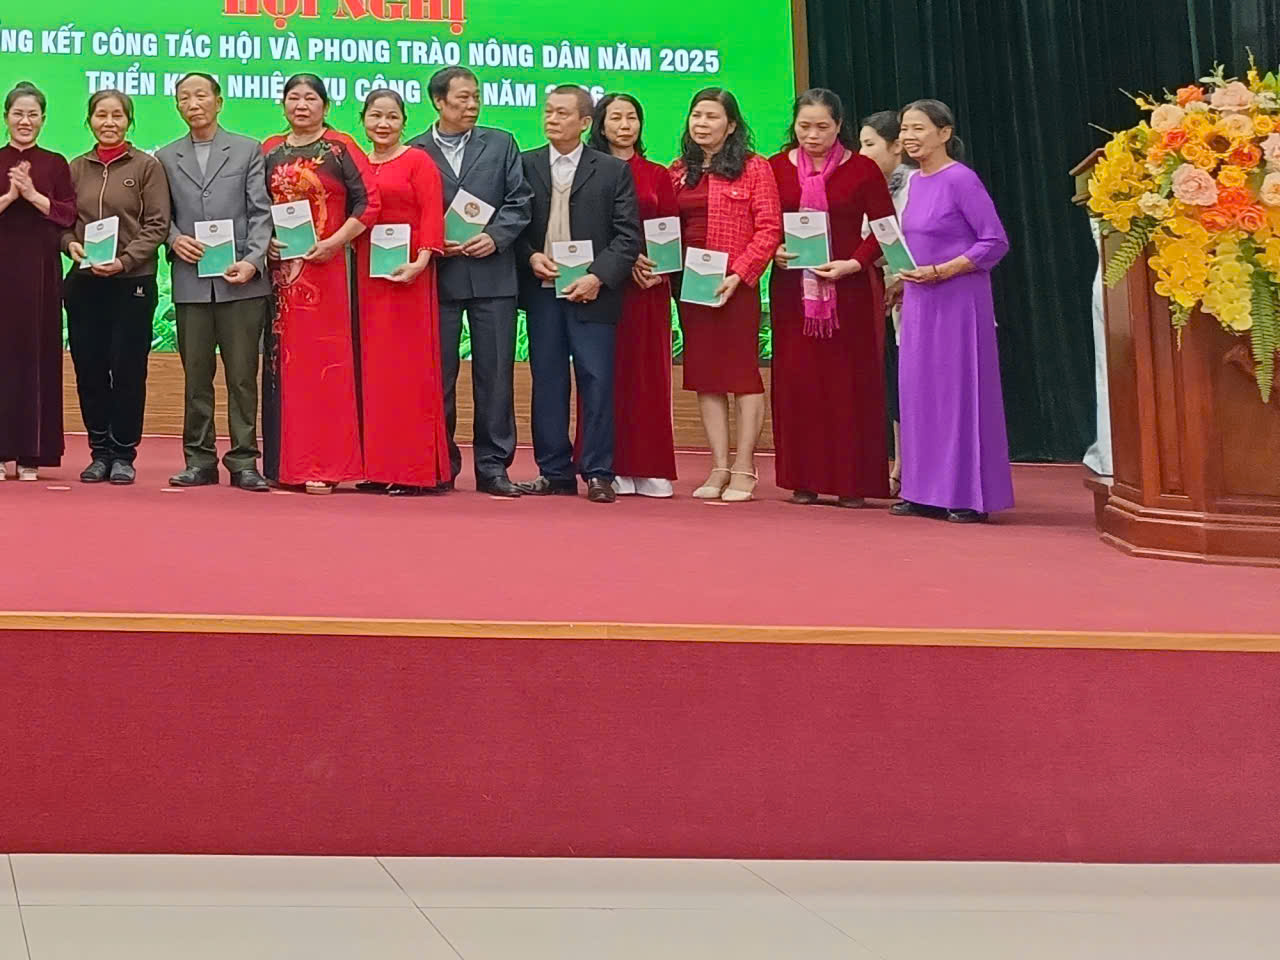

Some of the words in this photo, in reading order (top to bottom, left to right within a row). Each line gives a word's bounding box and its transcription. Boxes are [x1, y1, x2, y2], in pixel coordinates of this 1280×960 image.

[41, 23, 86, 54] KẾT
[92, 27, 158, 57] CÔNG
[165, 29, 211, 58] TÁC
[219, 31, 261, 64] HỘI
[268, 32, 301, 60] VÀ
[308, 38, 391, 63] PHONG
[397, 36, 461, 65] TRÀO
[468, 38, 534, 68] NÔNG
[542, 41, 590, 69] DÂN
[598, 43, 651, 71] NĂM
[659, 49, 720, 73] 2025
[85, 62, 155, 95] TRIỂN
[227, 70, 291, 105] NHIỆ
[483, 78, 537, 107] NĂM
